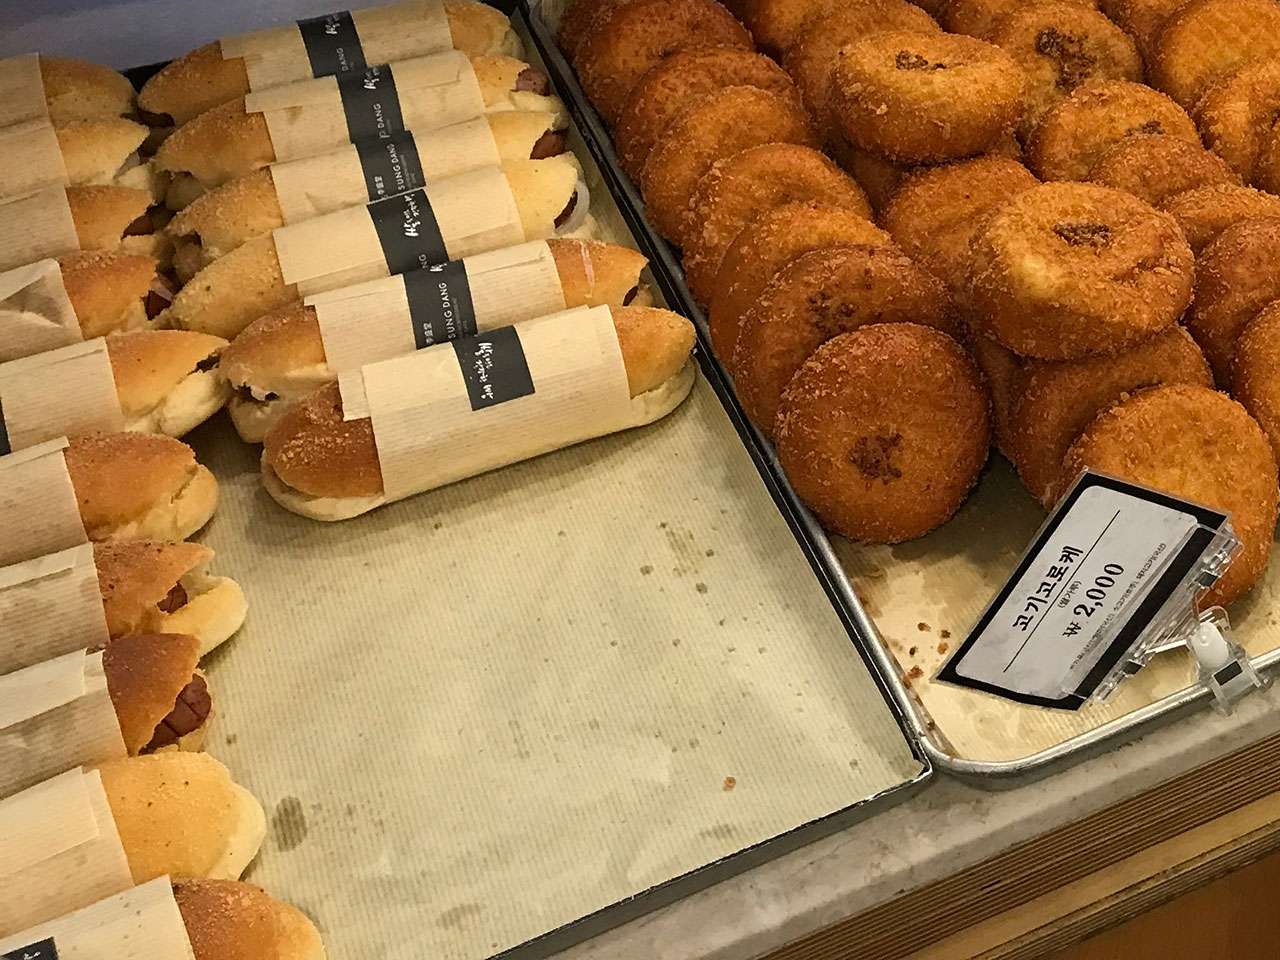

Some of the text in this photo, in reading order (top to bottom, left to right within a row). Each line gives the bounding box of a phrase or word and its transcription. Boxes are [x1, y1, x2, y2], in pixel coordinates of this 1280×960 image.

[374, 103, 385, 128] DANG
[439, 282, 456, 339] SUNG DANG
[1012, 545, 1084, 632] 고기고로케
[1073, 562, 1125, 618] 2,000
